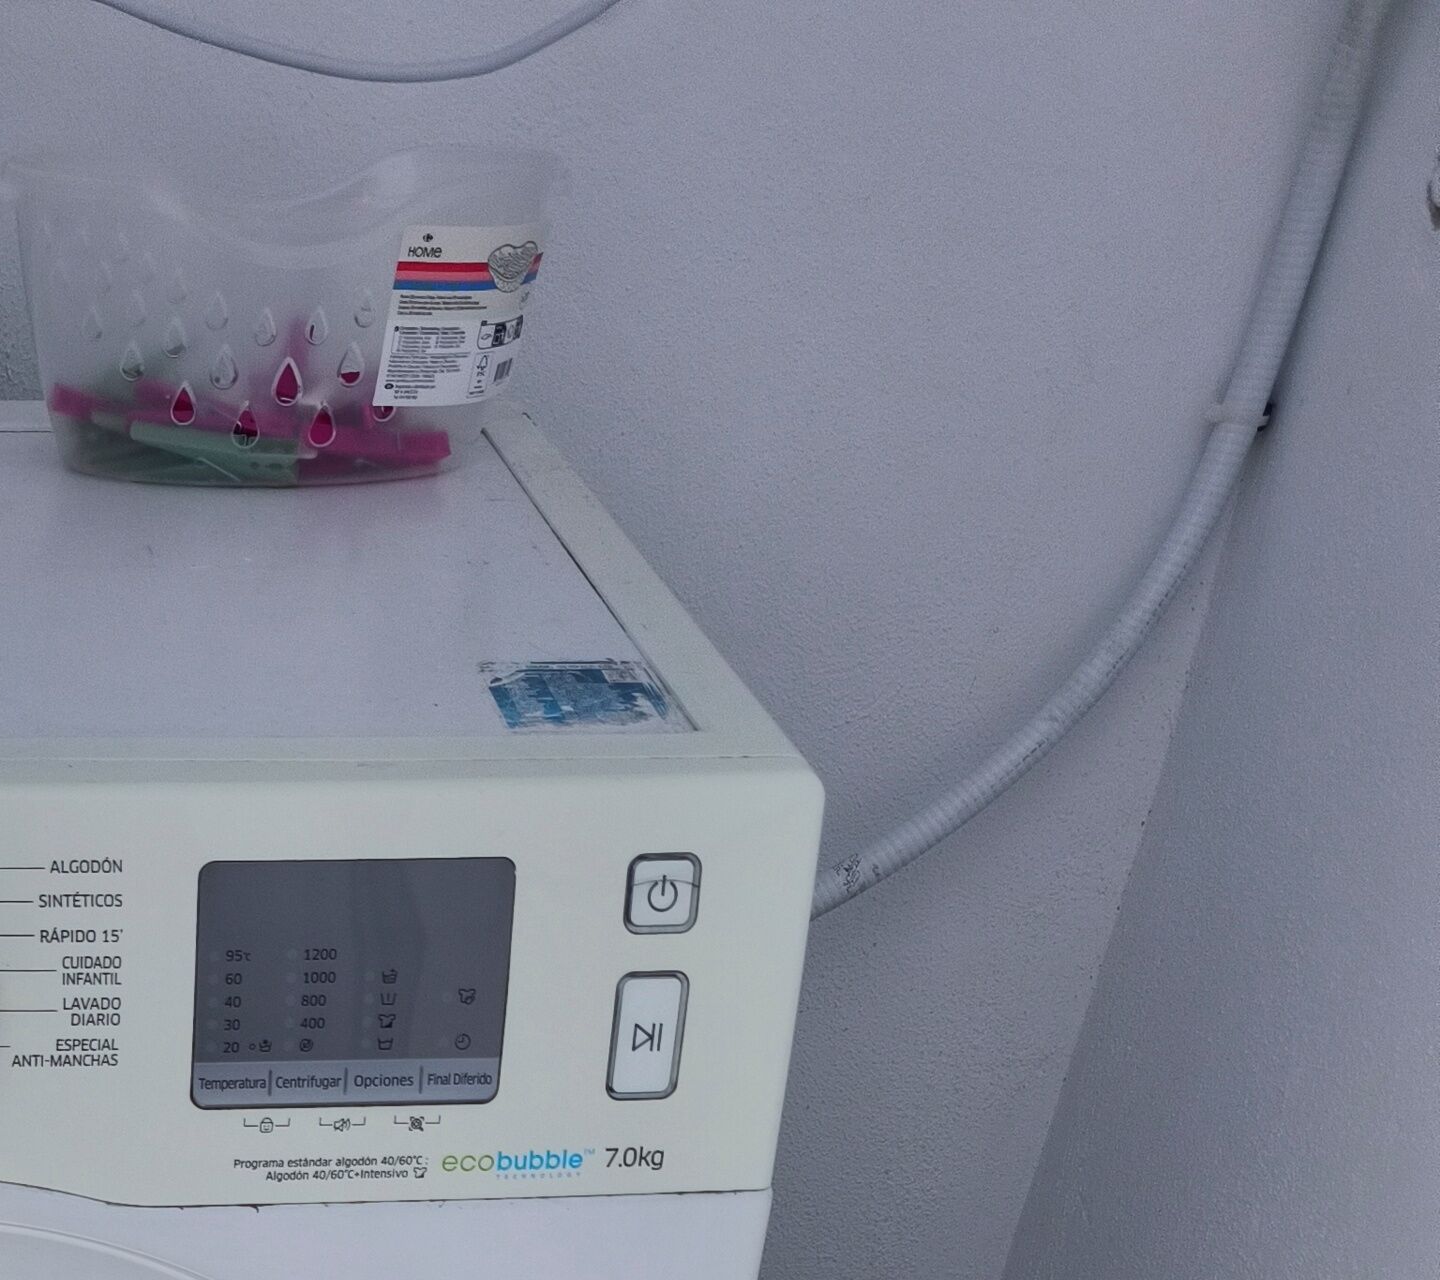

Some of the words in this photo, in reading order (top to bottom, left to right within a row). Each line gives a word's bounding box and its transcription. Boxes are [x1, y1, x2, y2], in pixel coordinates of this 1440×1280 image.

[49, 857, 123, 874] ALGODÓN
[38, 892, 123, 908] SINTÉTICOS
[40, 926, 97, 943] RÁPIDO
[304, 948, 337, 961] 1200
[61, 956, 122, 970] CUIDADO
[62, 972, 122, 986] INFANTIL
[225, 973, 242, 985] 60
[303, 971, 336, 984] 1000
[62, 997, 122, 1011] LAVADO
[224, 996, 241, 1008] 40
[301, 994, 327, 1007] 800
[70, 1013, 121, 1027] DIARIO
[223, 1019, 241, 1031] 30
[300, 1017, 326, 1030] 400
[55, 1038, 119, 1052] ESPECIAL
[223, 1041, 240, 1054] 20
[12, 1054, 118, 1068] ANTI-MANCHAS
[198, 1077, 267, 1093] Temperatura
[275, 1075, 342, 1091] Centrifugar
[353, 1074, 415, 1090] Opciones
[427, 1072, 452, 1086] Final
[453, 1072, 493, 1086] Diferido
[233, 1158, 284, 1170] Programa
[287, 1156, 332, 1168] estándar
[335, 1156, 377, 1168] algodón
[605, 1146, 665, 1170] 7.0kg
[265, 1170, 310, 1182] Algodón
